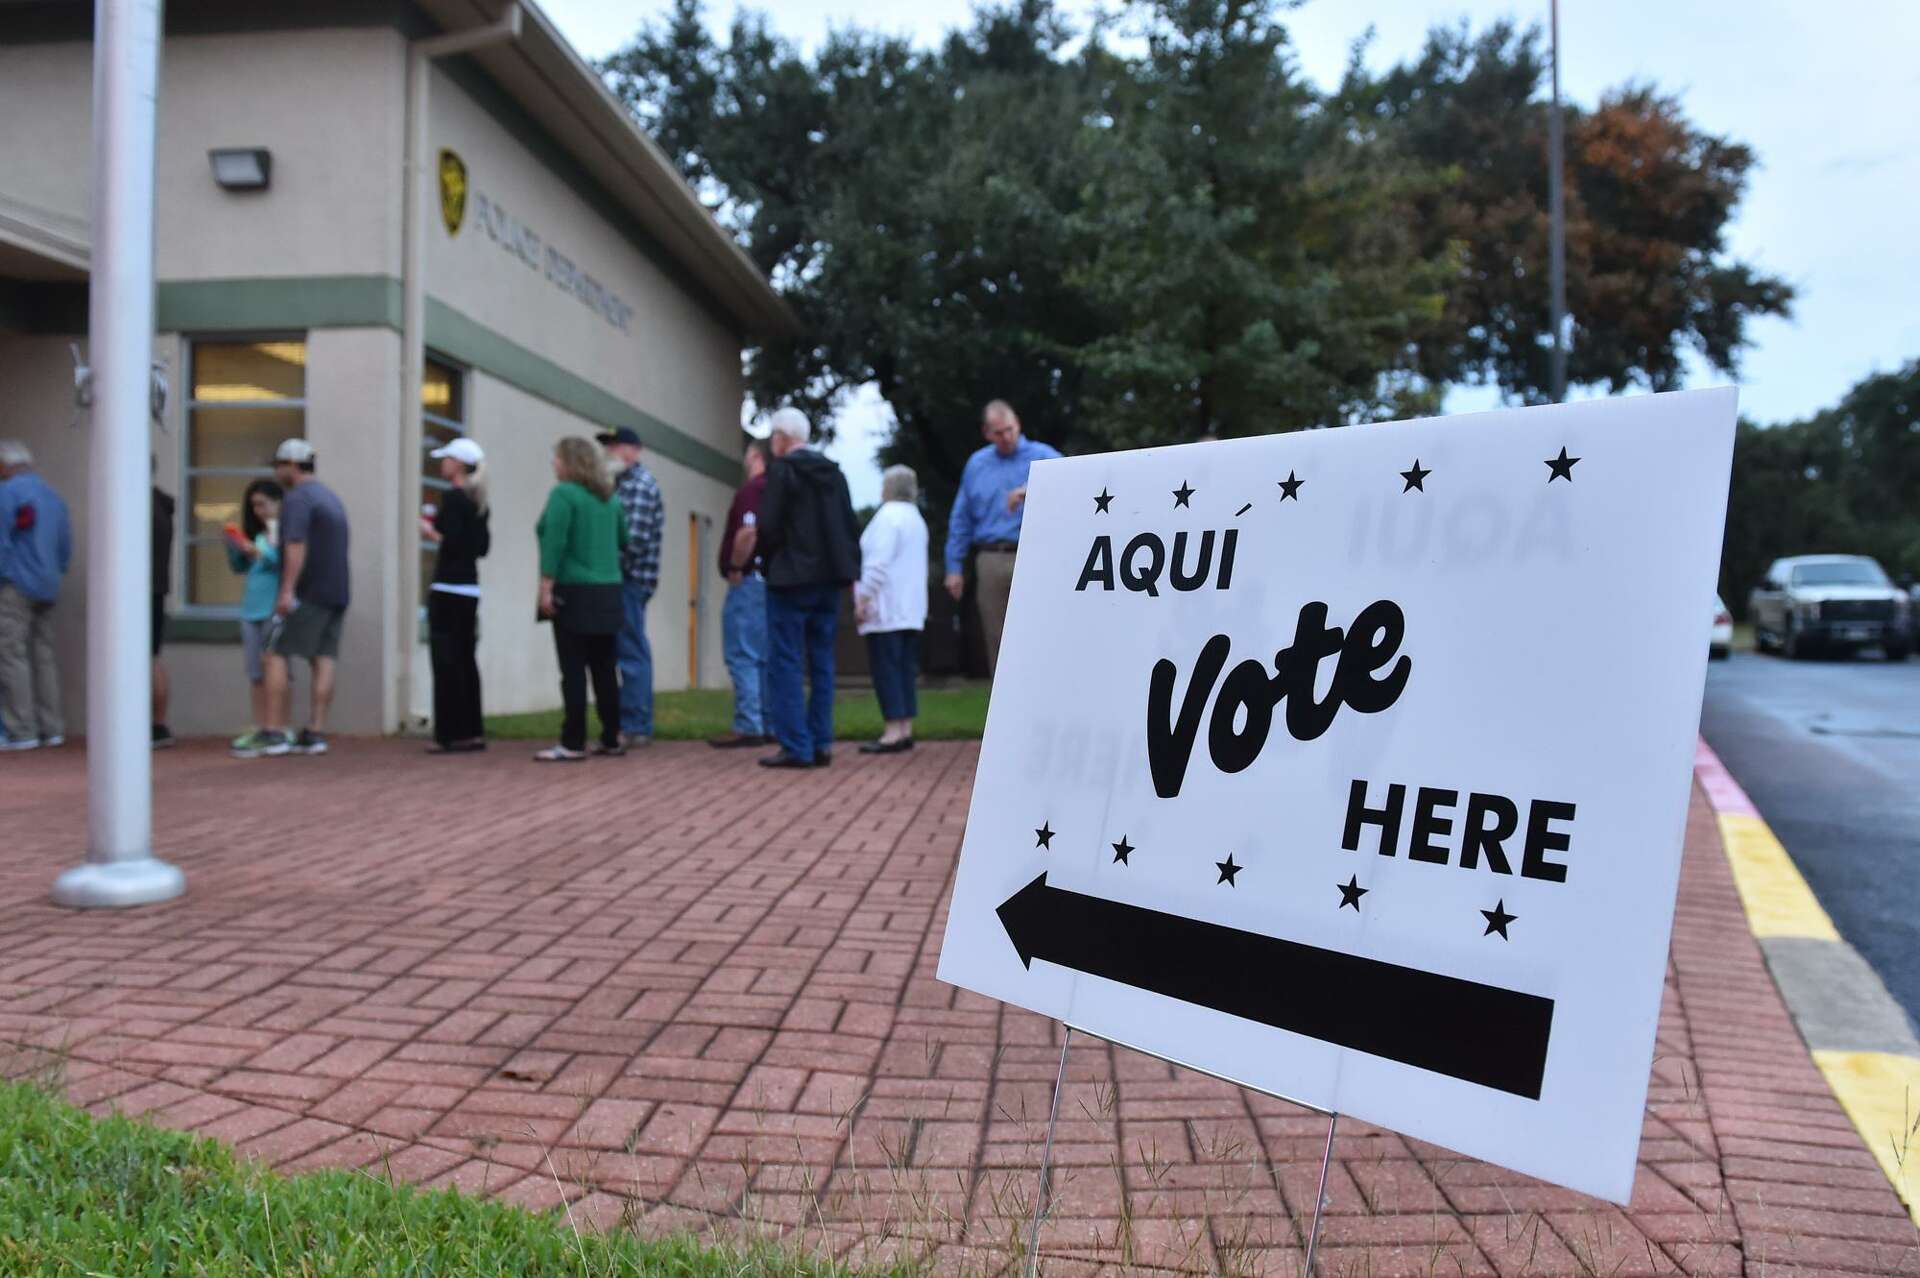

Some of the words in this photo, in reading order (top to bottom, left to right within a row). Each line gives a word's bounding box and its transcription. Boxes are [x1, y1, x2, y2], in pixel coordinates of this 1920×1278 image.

[1074, 502, 1253, 597] AQUÍ
[1146, 599, 1412, 799] Vote
[1341, 779, 1577, 884] HERE
